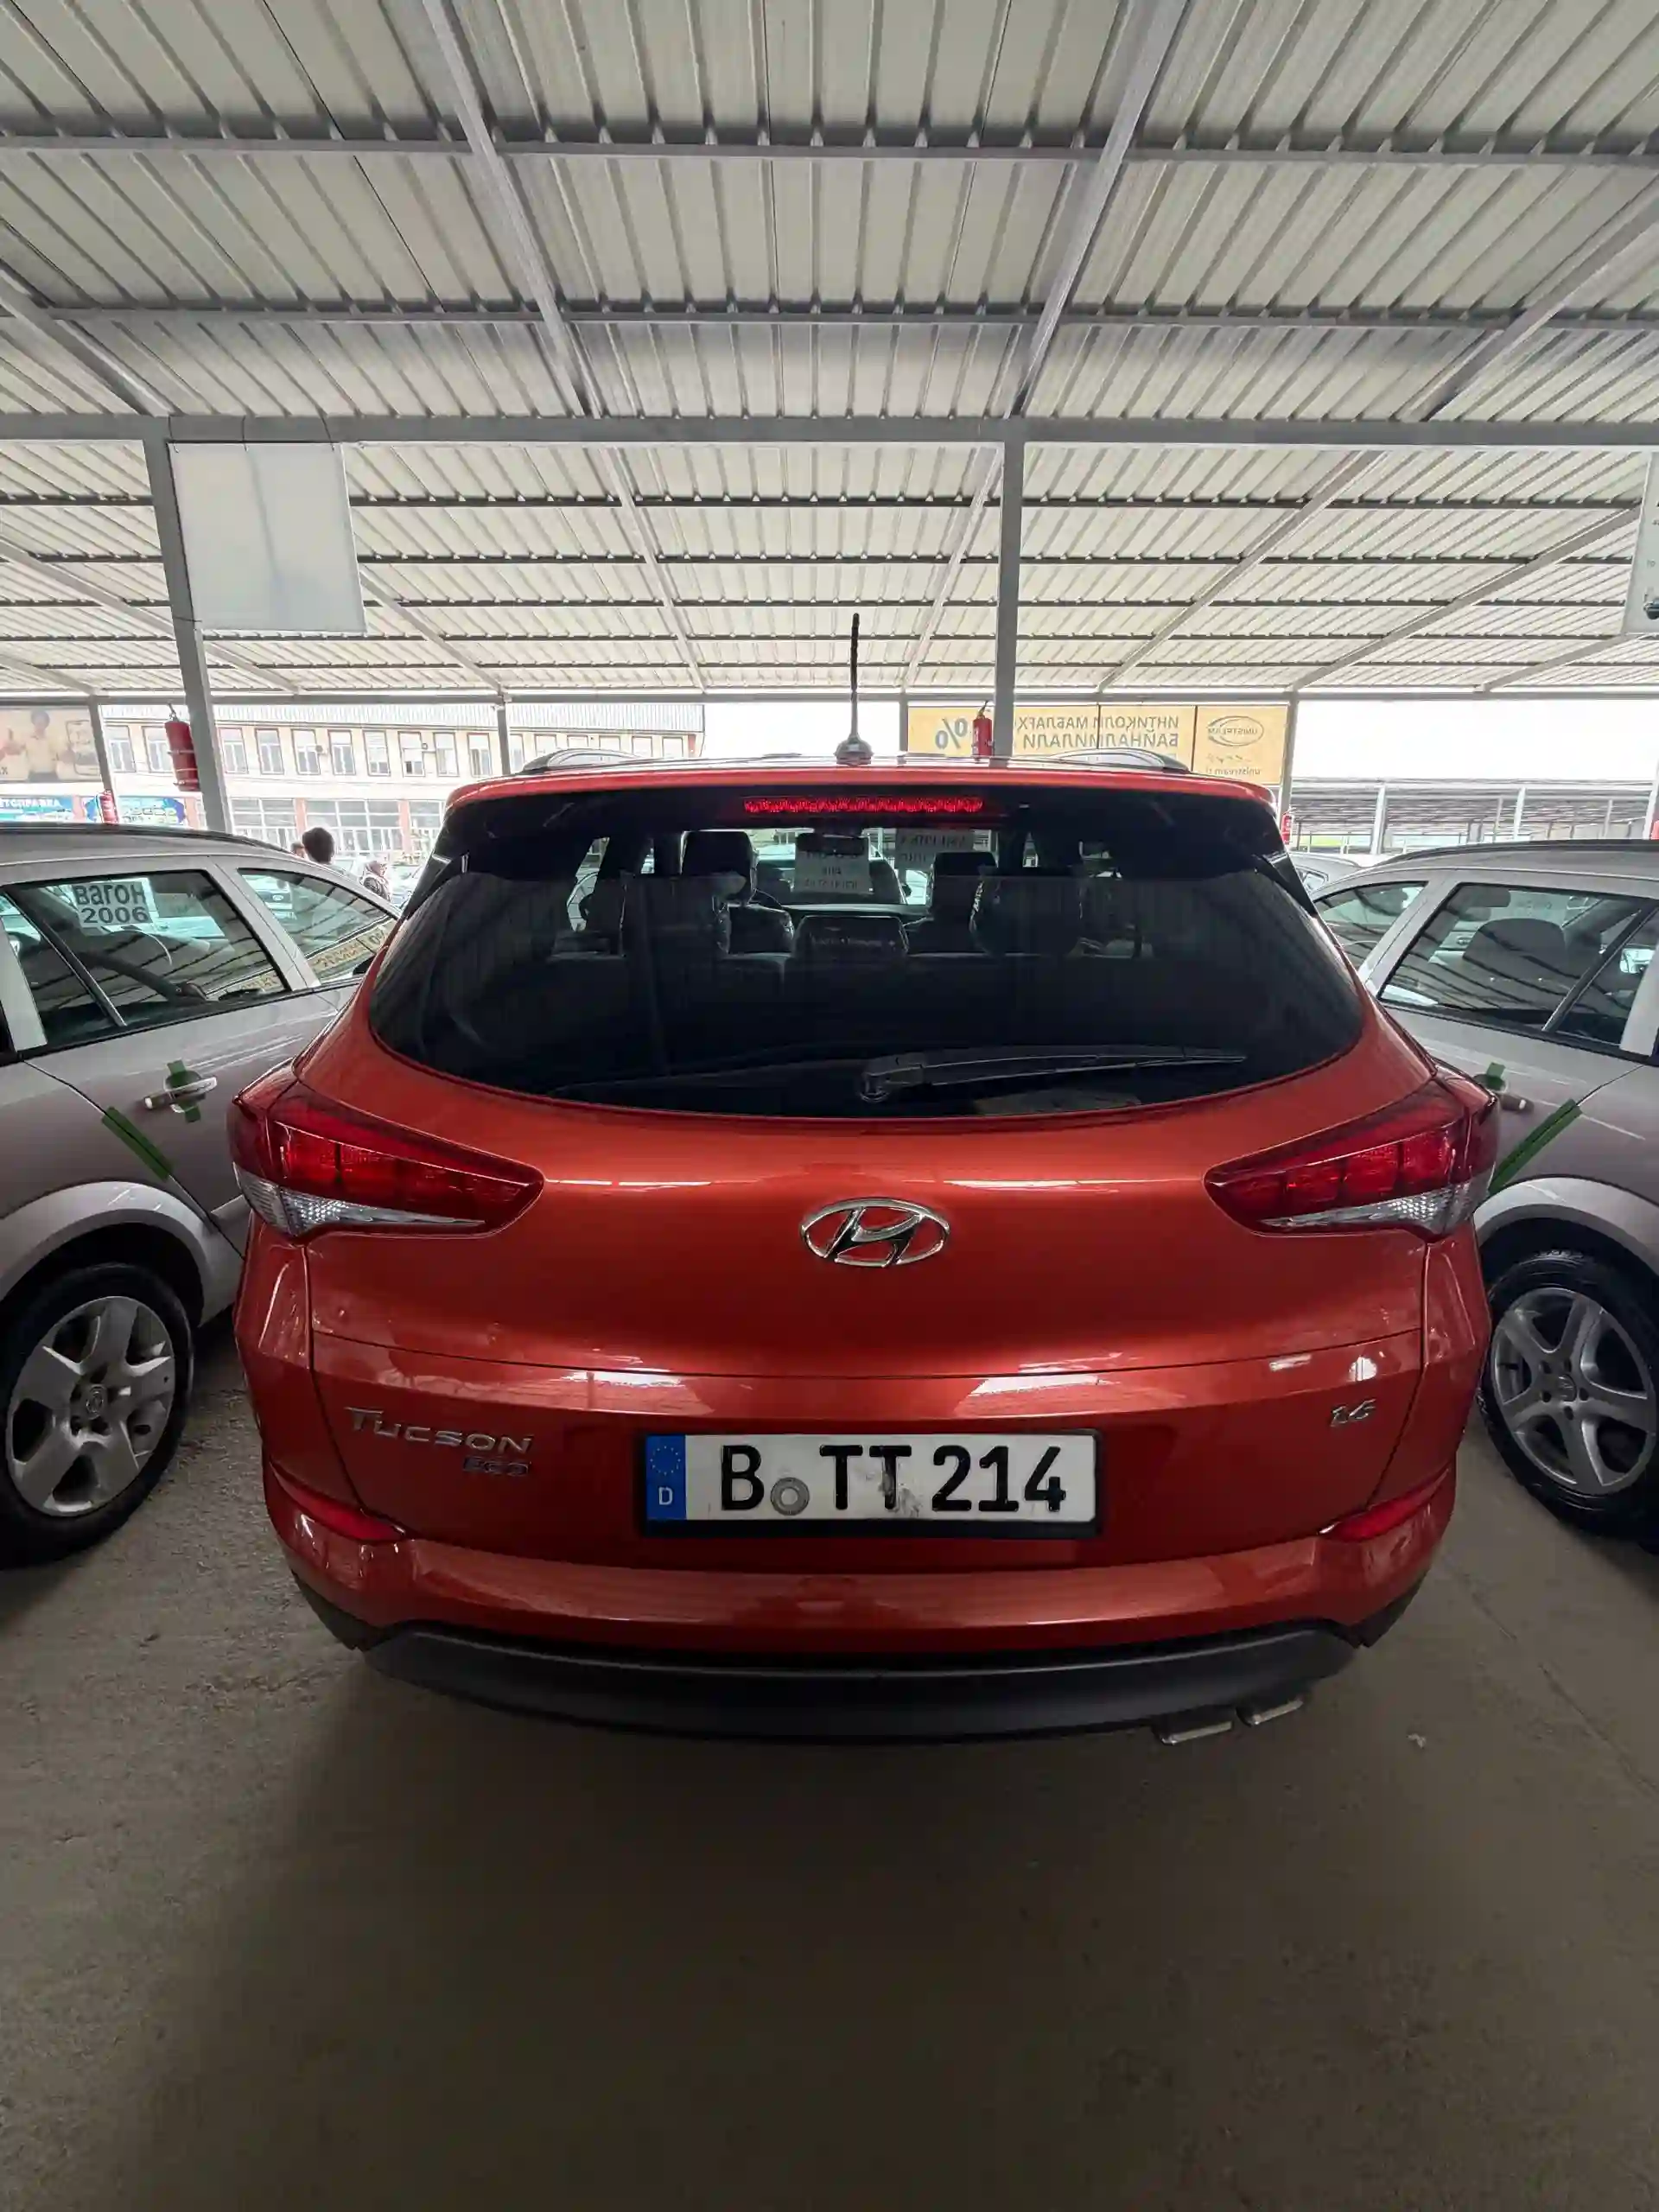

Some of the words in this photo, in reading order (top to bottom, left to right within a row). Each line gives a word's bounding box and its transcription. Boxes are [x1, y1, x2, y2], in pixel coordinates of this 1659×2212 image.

[81, 906, 149, 924] 2006
[931, 1444, 1067, 1512] 214
[658, 1486, 674, 1505] D
